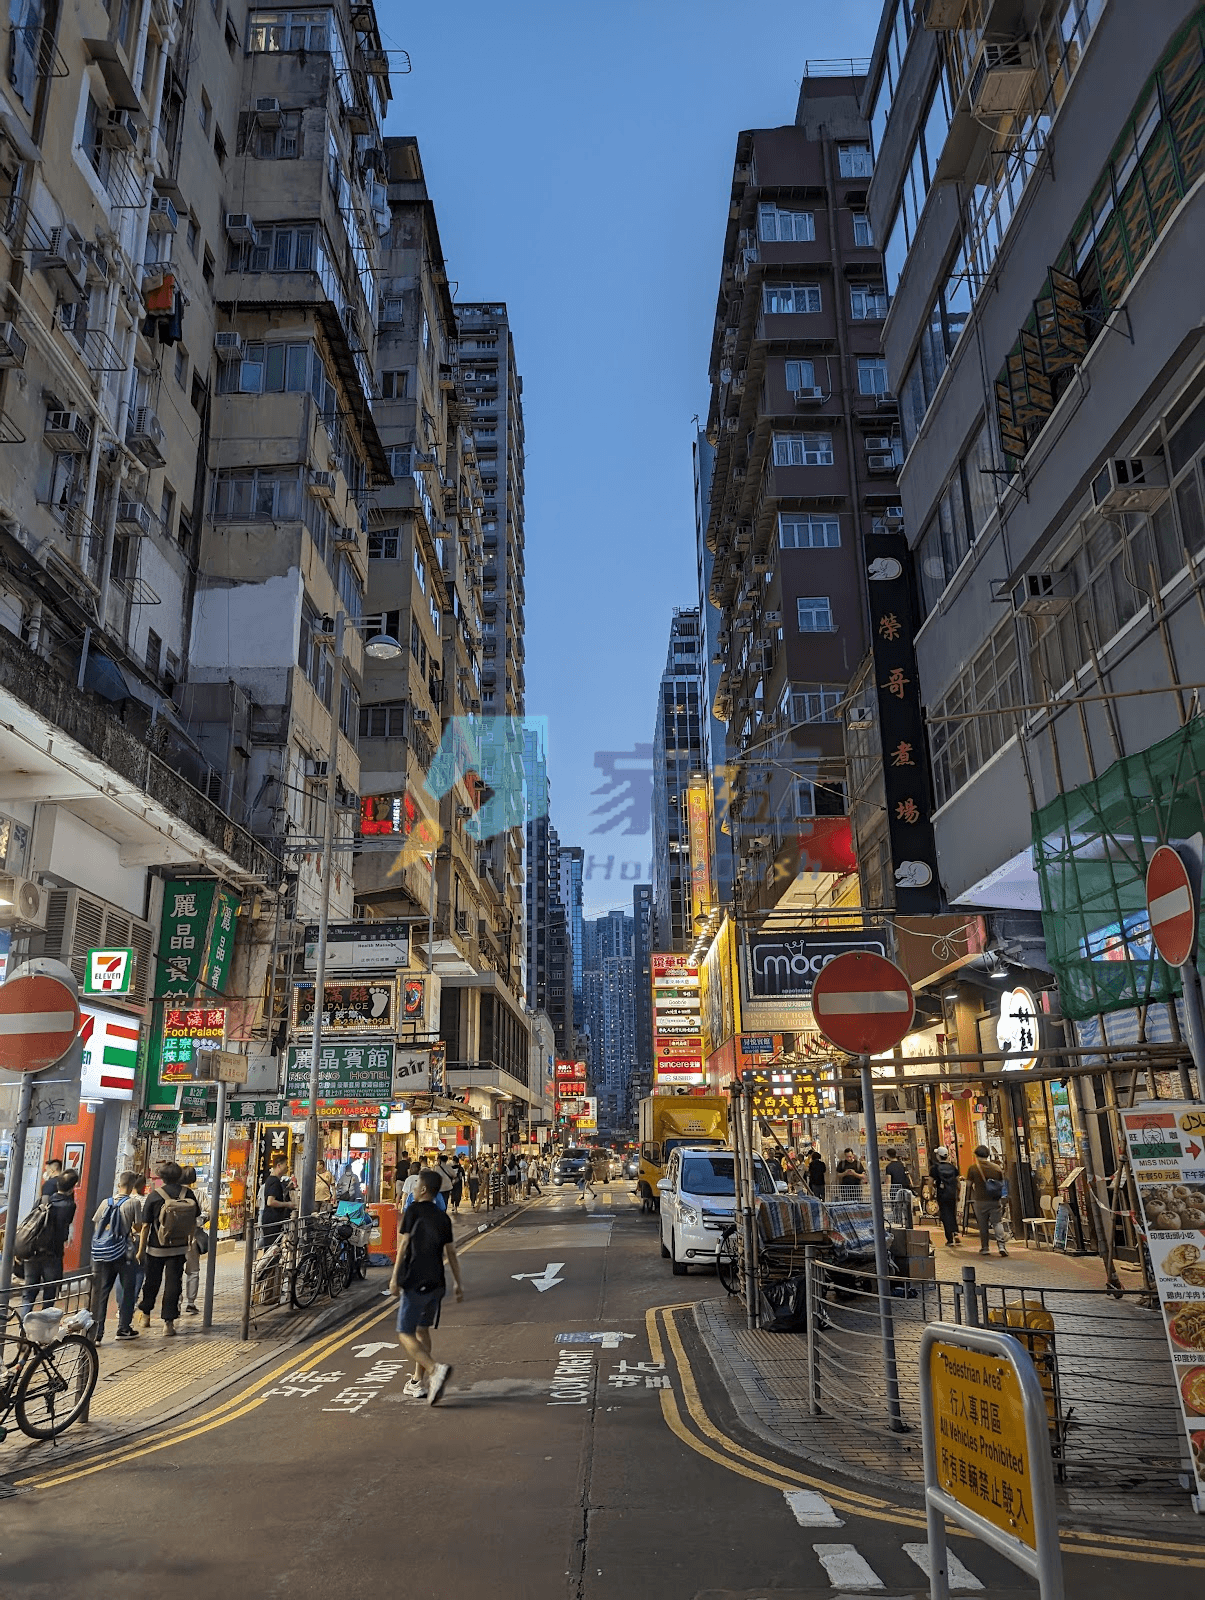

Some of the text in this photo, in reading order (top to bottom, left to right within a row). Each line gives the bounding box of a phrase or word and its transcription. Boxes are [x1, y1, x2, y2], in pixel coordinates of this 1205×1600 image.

[878, 613, 921, 825] 榮哥煮場
[327, 1002, 369, 1011] PALACE
[165, 1027, 225, 1037] Foot Palace
[349, 1070, 391, 1080] HOTEL
[321, 1107, 343, 1115] BODY
[321, 1359, 409, 1413] LOOK LEFT
[546, 1349, 594, 1405] LOOK RIGHT
[943, 1354, 1003, 1391] Pedestrian Area
[949, 1387, 1003, 1435] 行人專用區
[940, 1416, 1024, 1476] All Vehicles Prohibited
[941, 1446, 1029, 1525] 所有車輛禁止駛入
